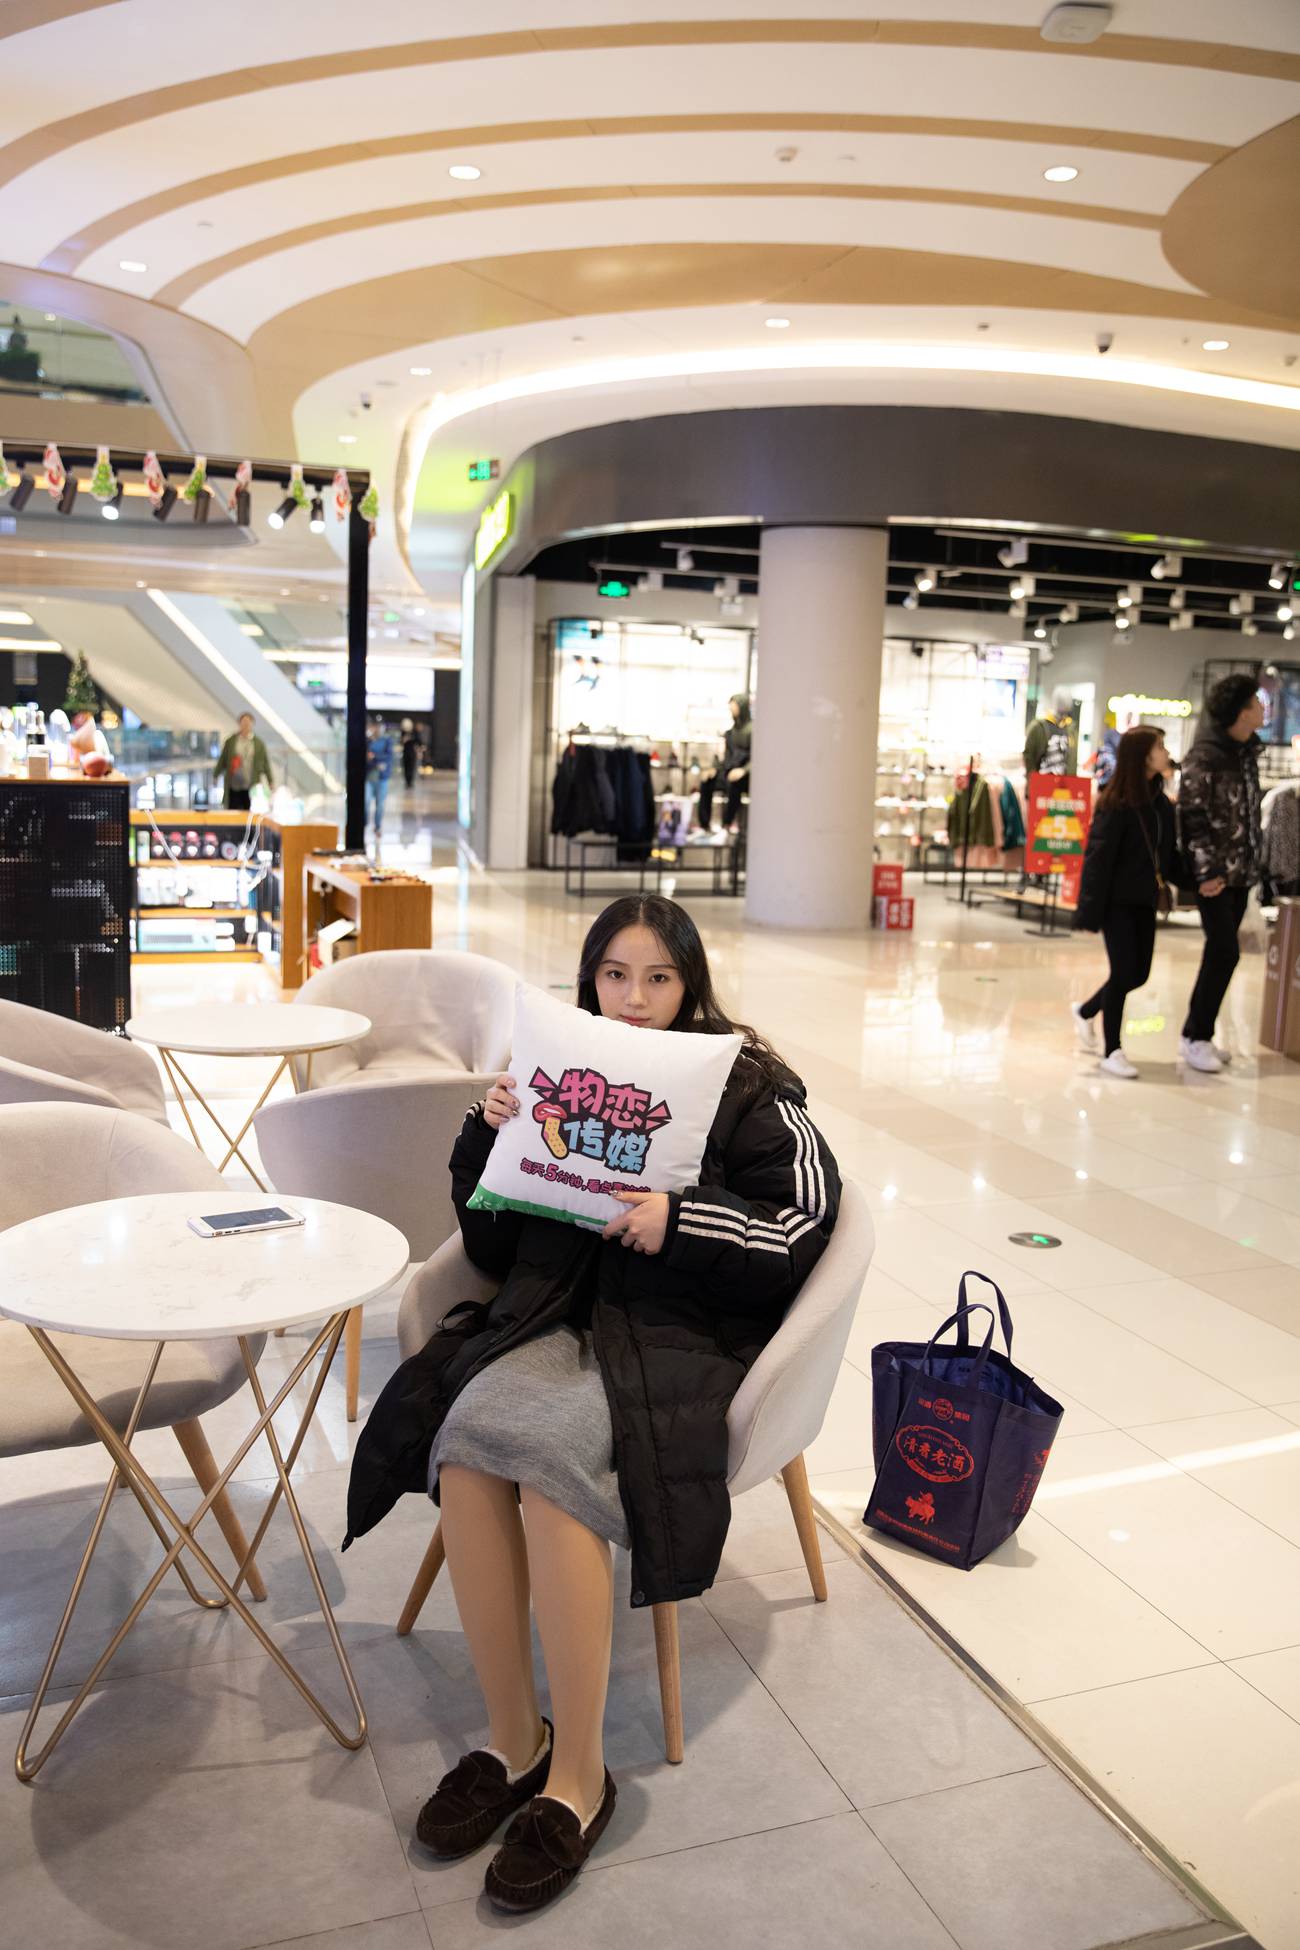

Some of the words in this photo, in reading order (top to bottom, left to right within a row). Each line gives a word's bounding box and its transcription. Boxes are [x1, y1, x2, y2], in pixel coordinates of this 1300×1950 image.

[558, 1068, 652, 1131] 物恋
[562, 1117, 651, 1175] 传媒
[519, 1157, 651, 1193] 每天5分钟，看点
[903, 1435, 966, 1473] 清香老酒
